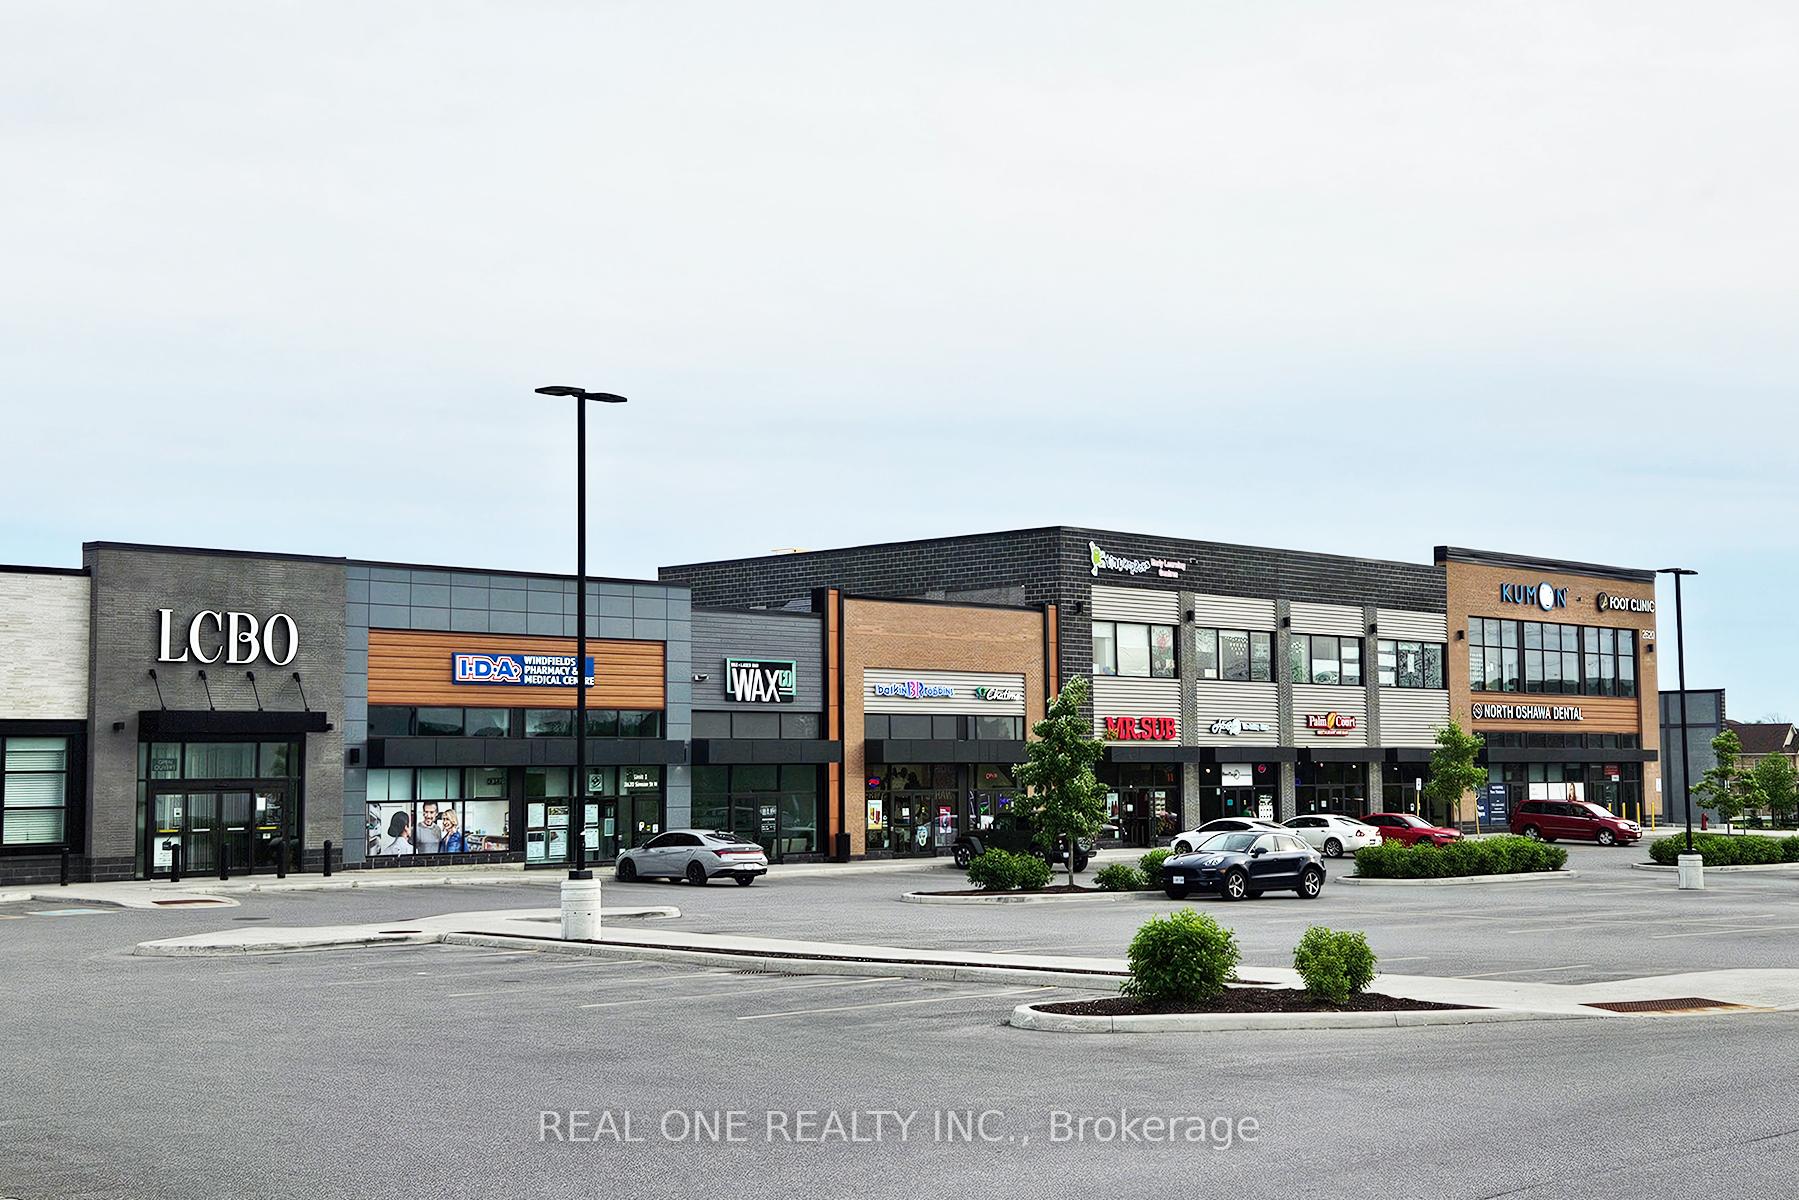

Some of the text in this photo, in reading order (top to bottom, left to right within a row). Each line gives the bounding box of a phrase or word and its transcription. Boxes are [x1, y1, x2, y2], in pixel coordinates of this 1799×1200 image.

[1501, 581, 1566, 612] KUMON
[1609, 596, 1655, 613] FOOT CLINIC
[157, 607, 300, 667] LCBO
[523, 655, 577, 667] WINDFIELDS
[523, 665, 579, 676] PHARMACY &
[523, 675, 594, 686] MEDICAL CENRE
[731, 667, 781, 703] WAX
[1484, 704, 1584, 720] NORTH OSHAWA DENTAL
[1309, 715, 1356, 727] Palm Court
